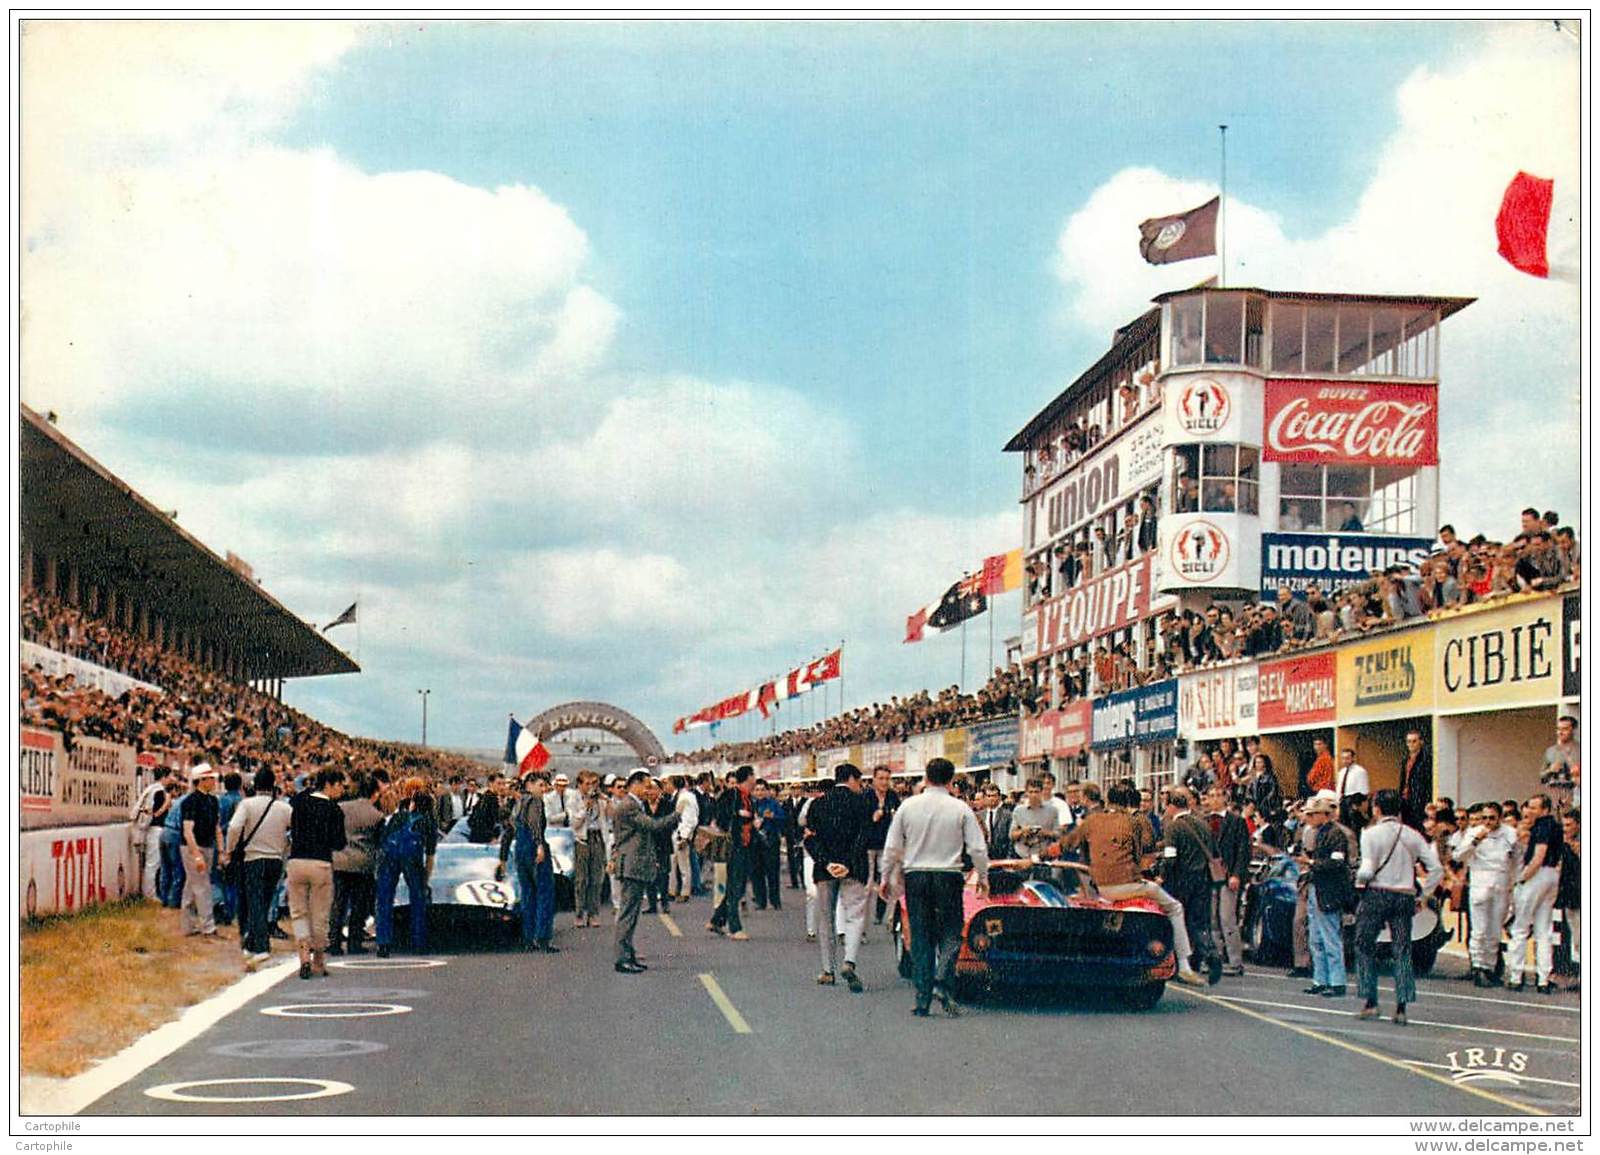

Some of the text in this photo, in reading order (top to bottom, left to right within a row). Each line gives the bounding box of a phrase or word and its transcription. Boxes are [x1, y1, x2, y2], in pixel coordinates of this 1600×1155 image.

[1317, 388, 1369, 400] BUVEZ
[1186, 419, 1218, 430] SICLI
[1268, 398, 1432, 458] Coca-Cola
[1182, 562, 1214, 574] SICLI
[1267, 538, 1429, 580] moteurs
[1444, 617, 1552, 693] CIBIÉ
[1285, 678, 1336, 714] MARCHAL
[549, 712, 628, 732] DUNLOP
[52, 836, 107, 914] TOTAL
[466, 881, 509, 904] 18
